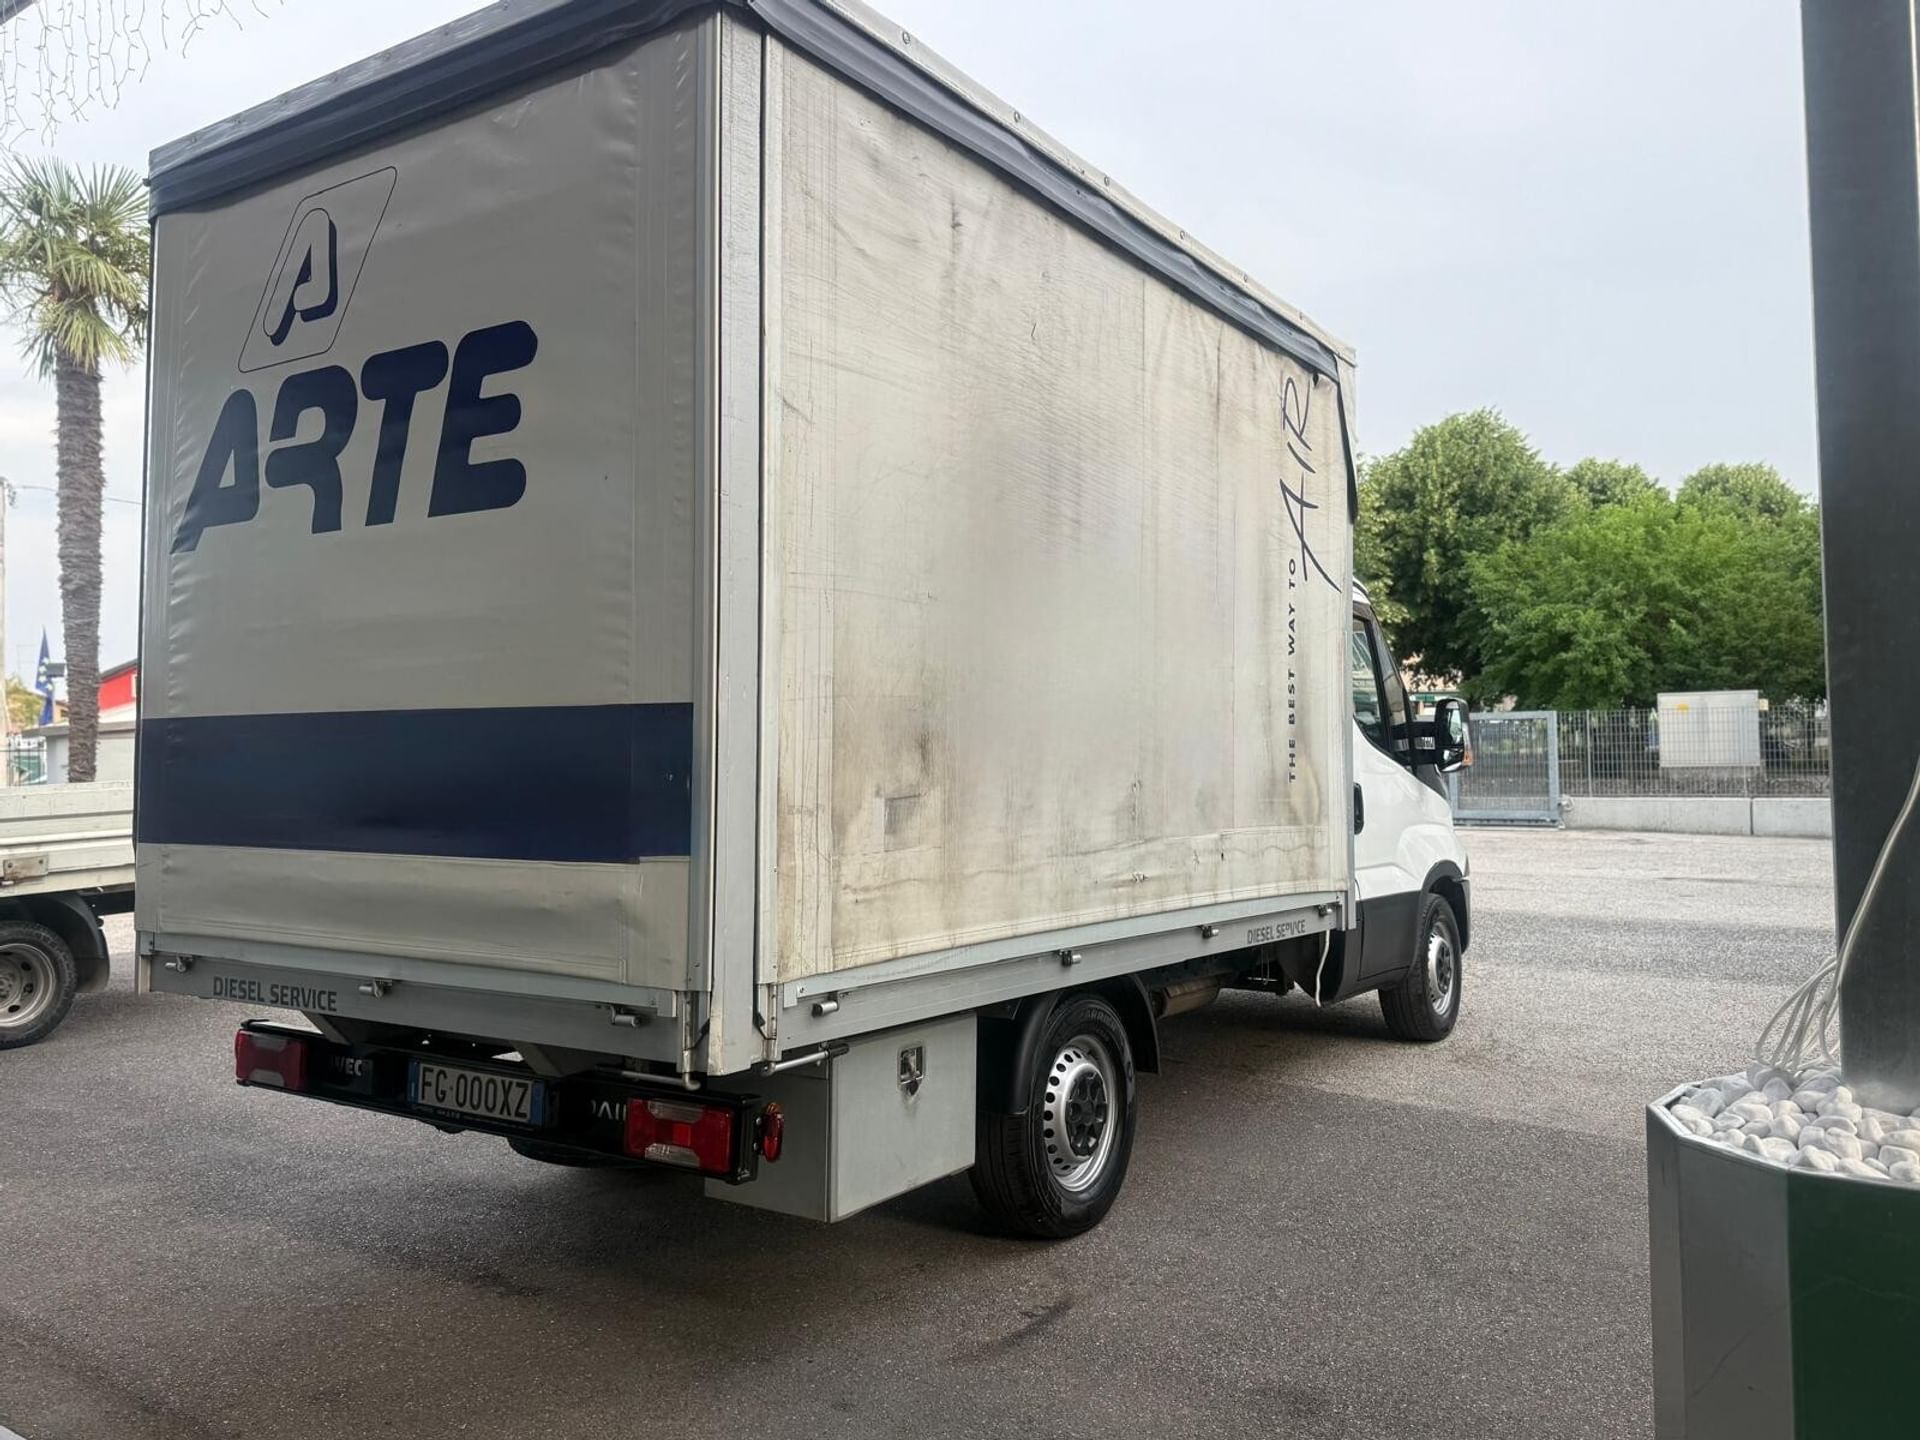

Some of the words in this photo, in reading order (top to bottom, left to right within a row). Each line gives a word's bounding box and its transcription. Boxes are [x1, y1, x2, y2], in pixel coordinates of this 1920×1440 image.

[170, 320, 538, 554] ARTE
[1288, 558, 1296, 590] TO
[1288, 603, 1296, 656] WAY
[1288, 669, 1296, 725] BEST
[1288, 740, 1296, 783] THE
[213, 975, 264, 1002] DIESEL
[270, 983, 338, 1012] SERVICE
